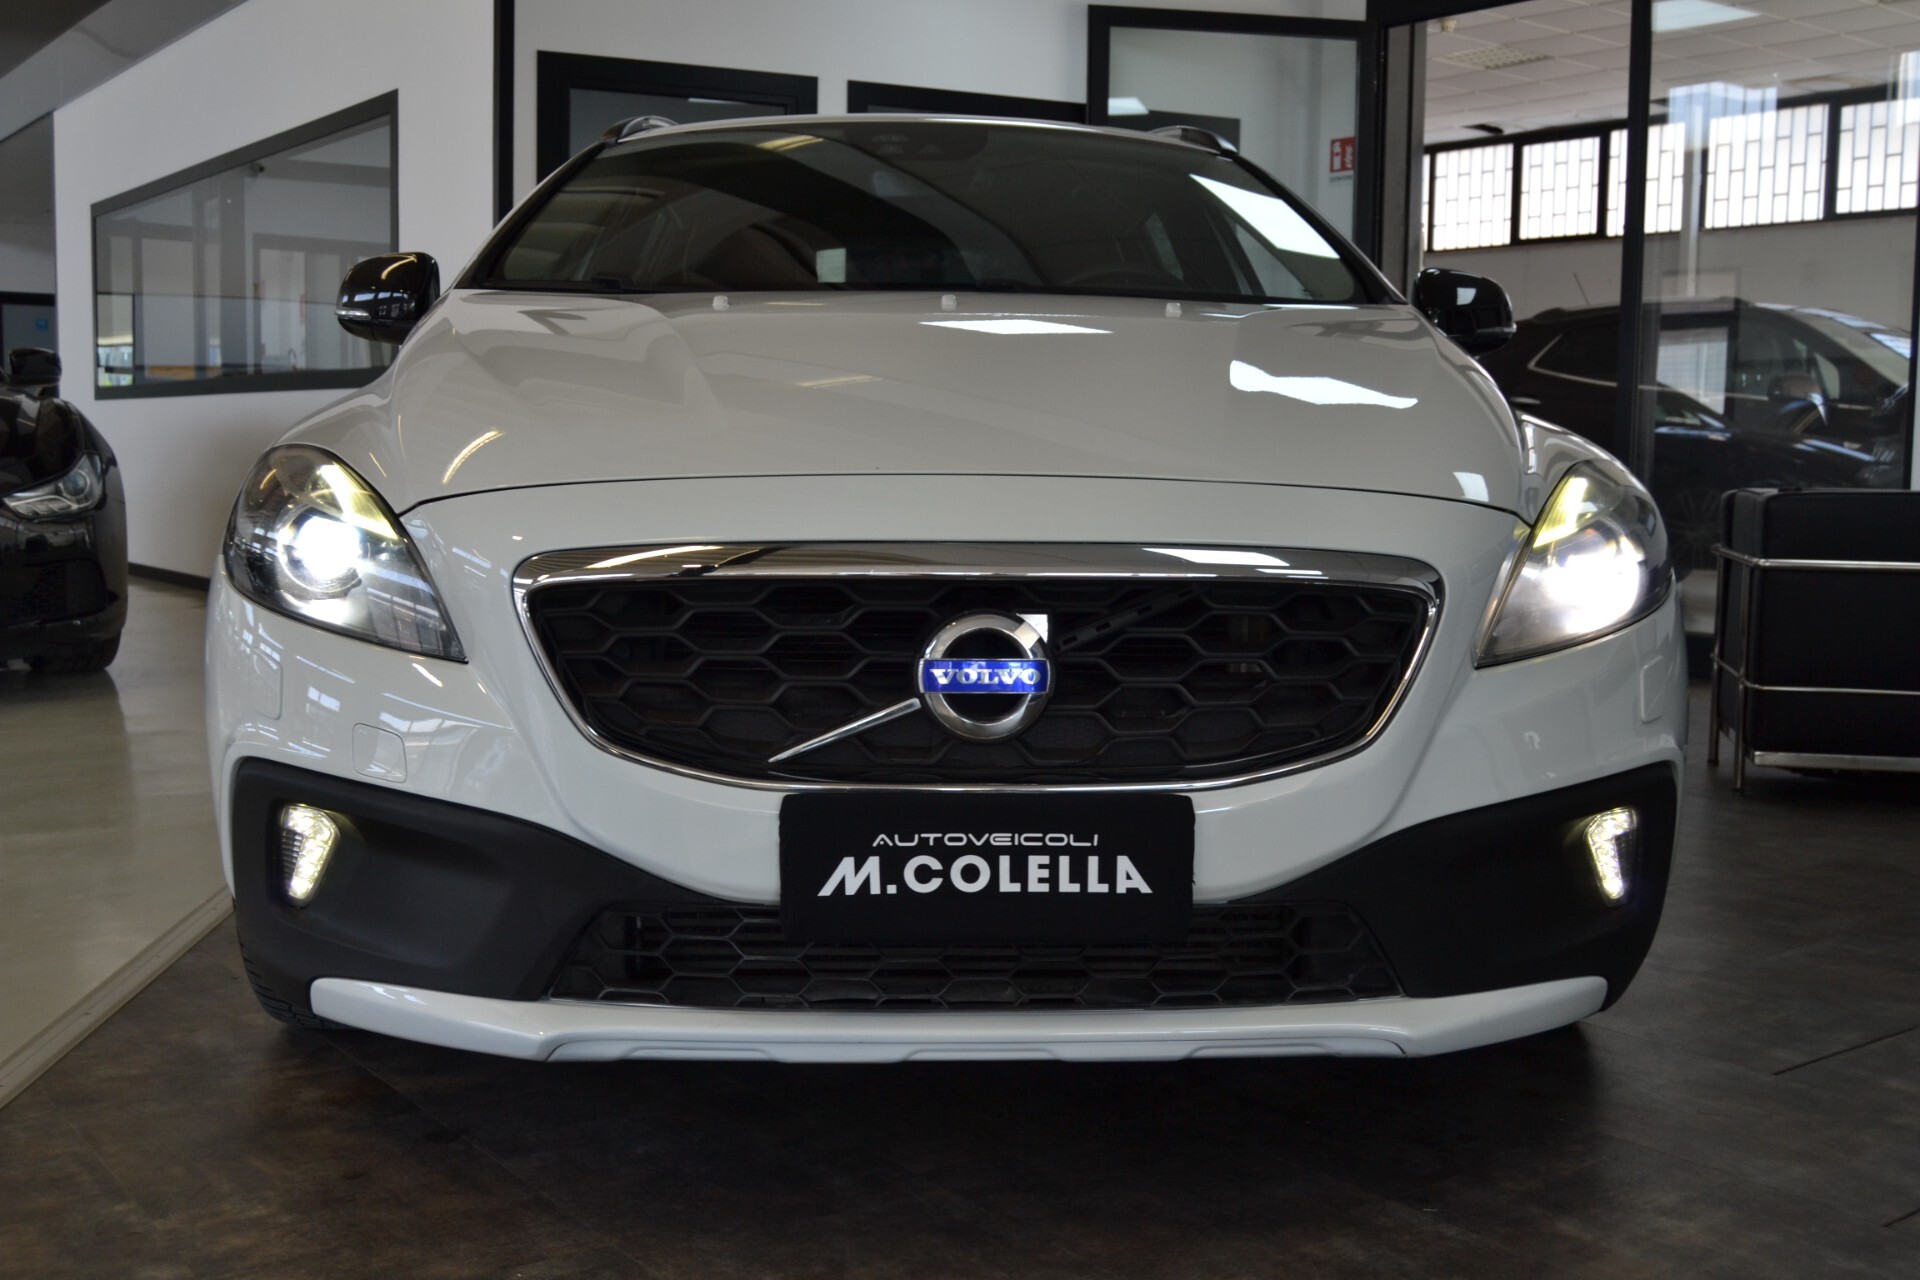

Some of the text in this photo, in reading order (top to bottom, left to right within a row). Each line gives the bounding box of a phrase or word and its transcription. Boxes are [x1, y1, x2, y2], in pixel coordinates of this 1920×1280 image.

[929, 668, 1042, 685] VOLVO
[872, 833, 1098, 847] AUTOVEICOLI
[817, 854, 1153, 896] M.COLELLA
